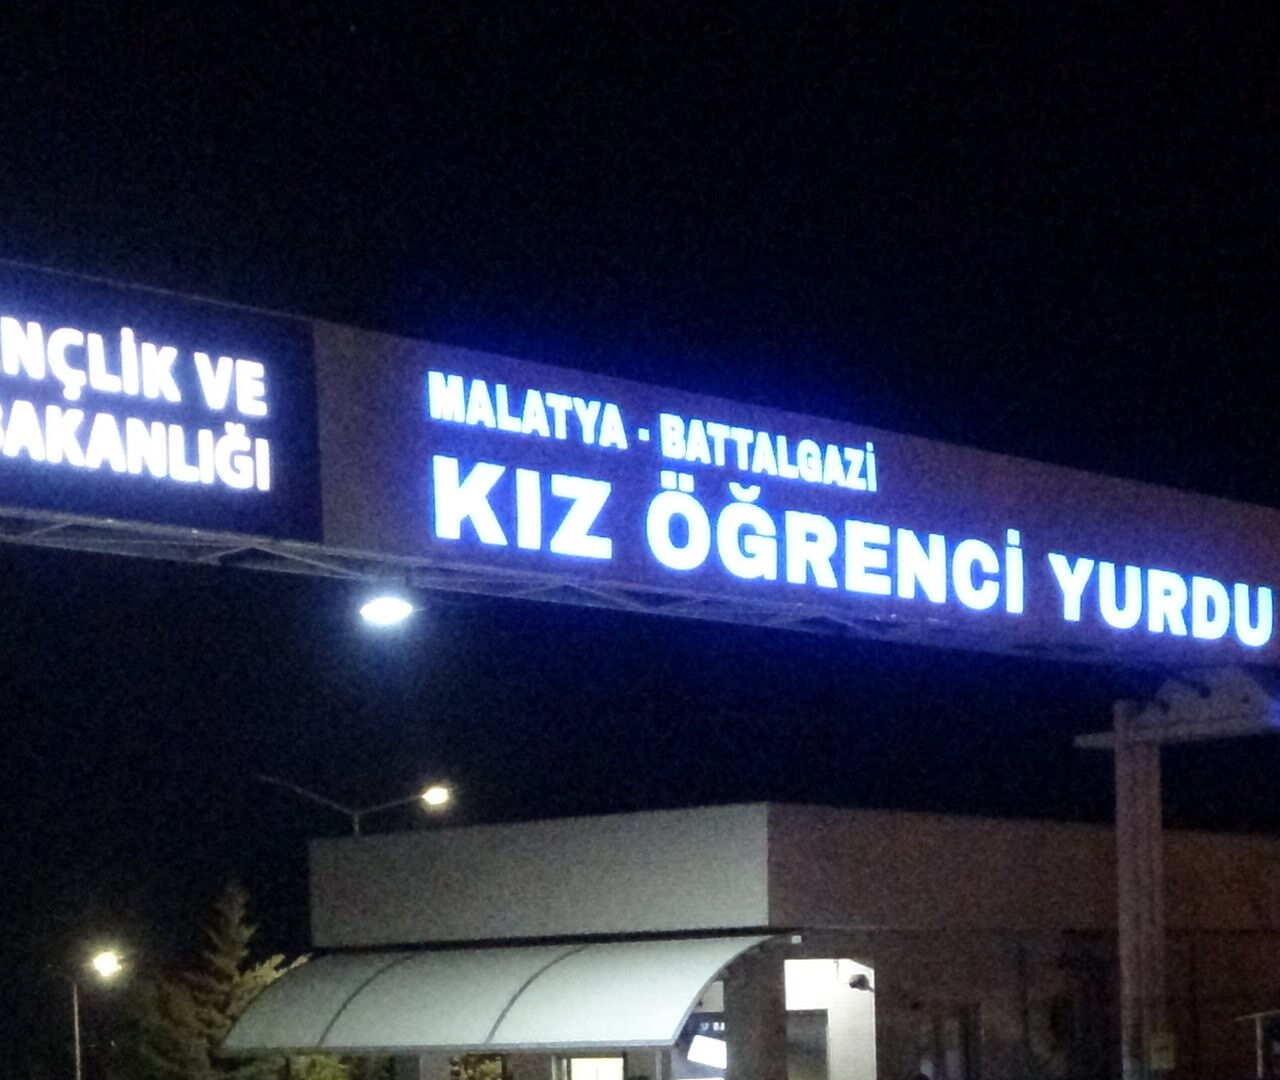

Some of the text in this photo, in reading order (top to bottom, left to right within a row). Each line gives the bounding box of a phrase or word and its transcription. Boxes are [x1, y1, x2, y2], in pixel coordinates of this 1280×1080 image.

[193, 350, 269, 418] VE
[427, 371, 629, 450] MALATYA
[658, 412, 878, 493] BATTALGAZİ
[432, 454, 1274, 648] KIZ ÖĞRENCİ YURDU
